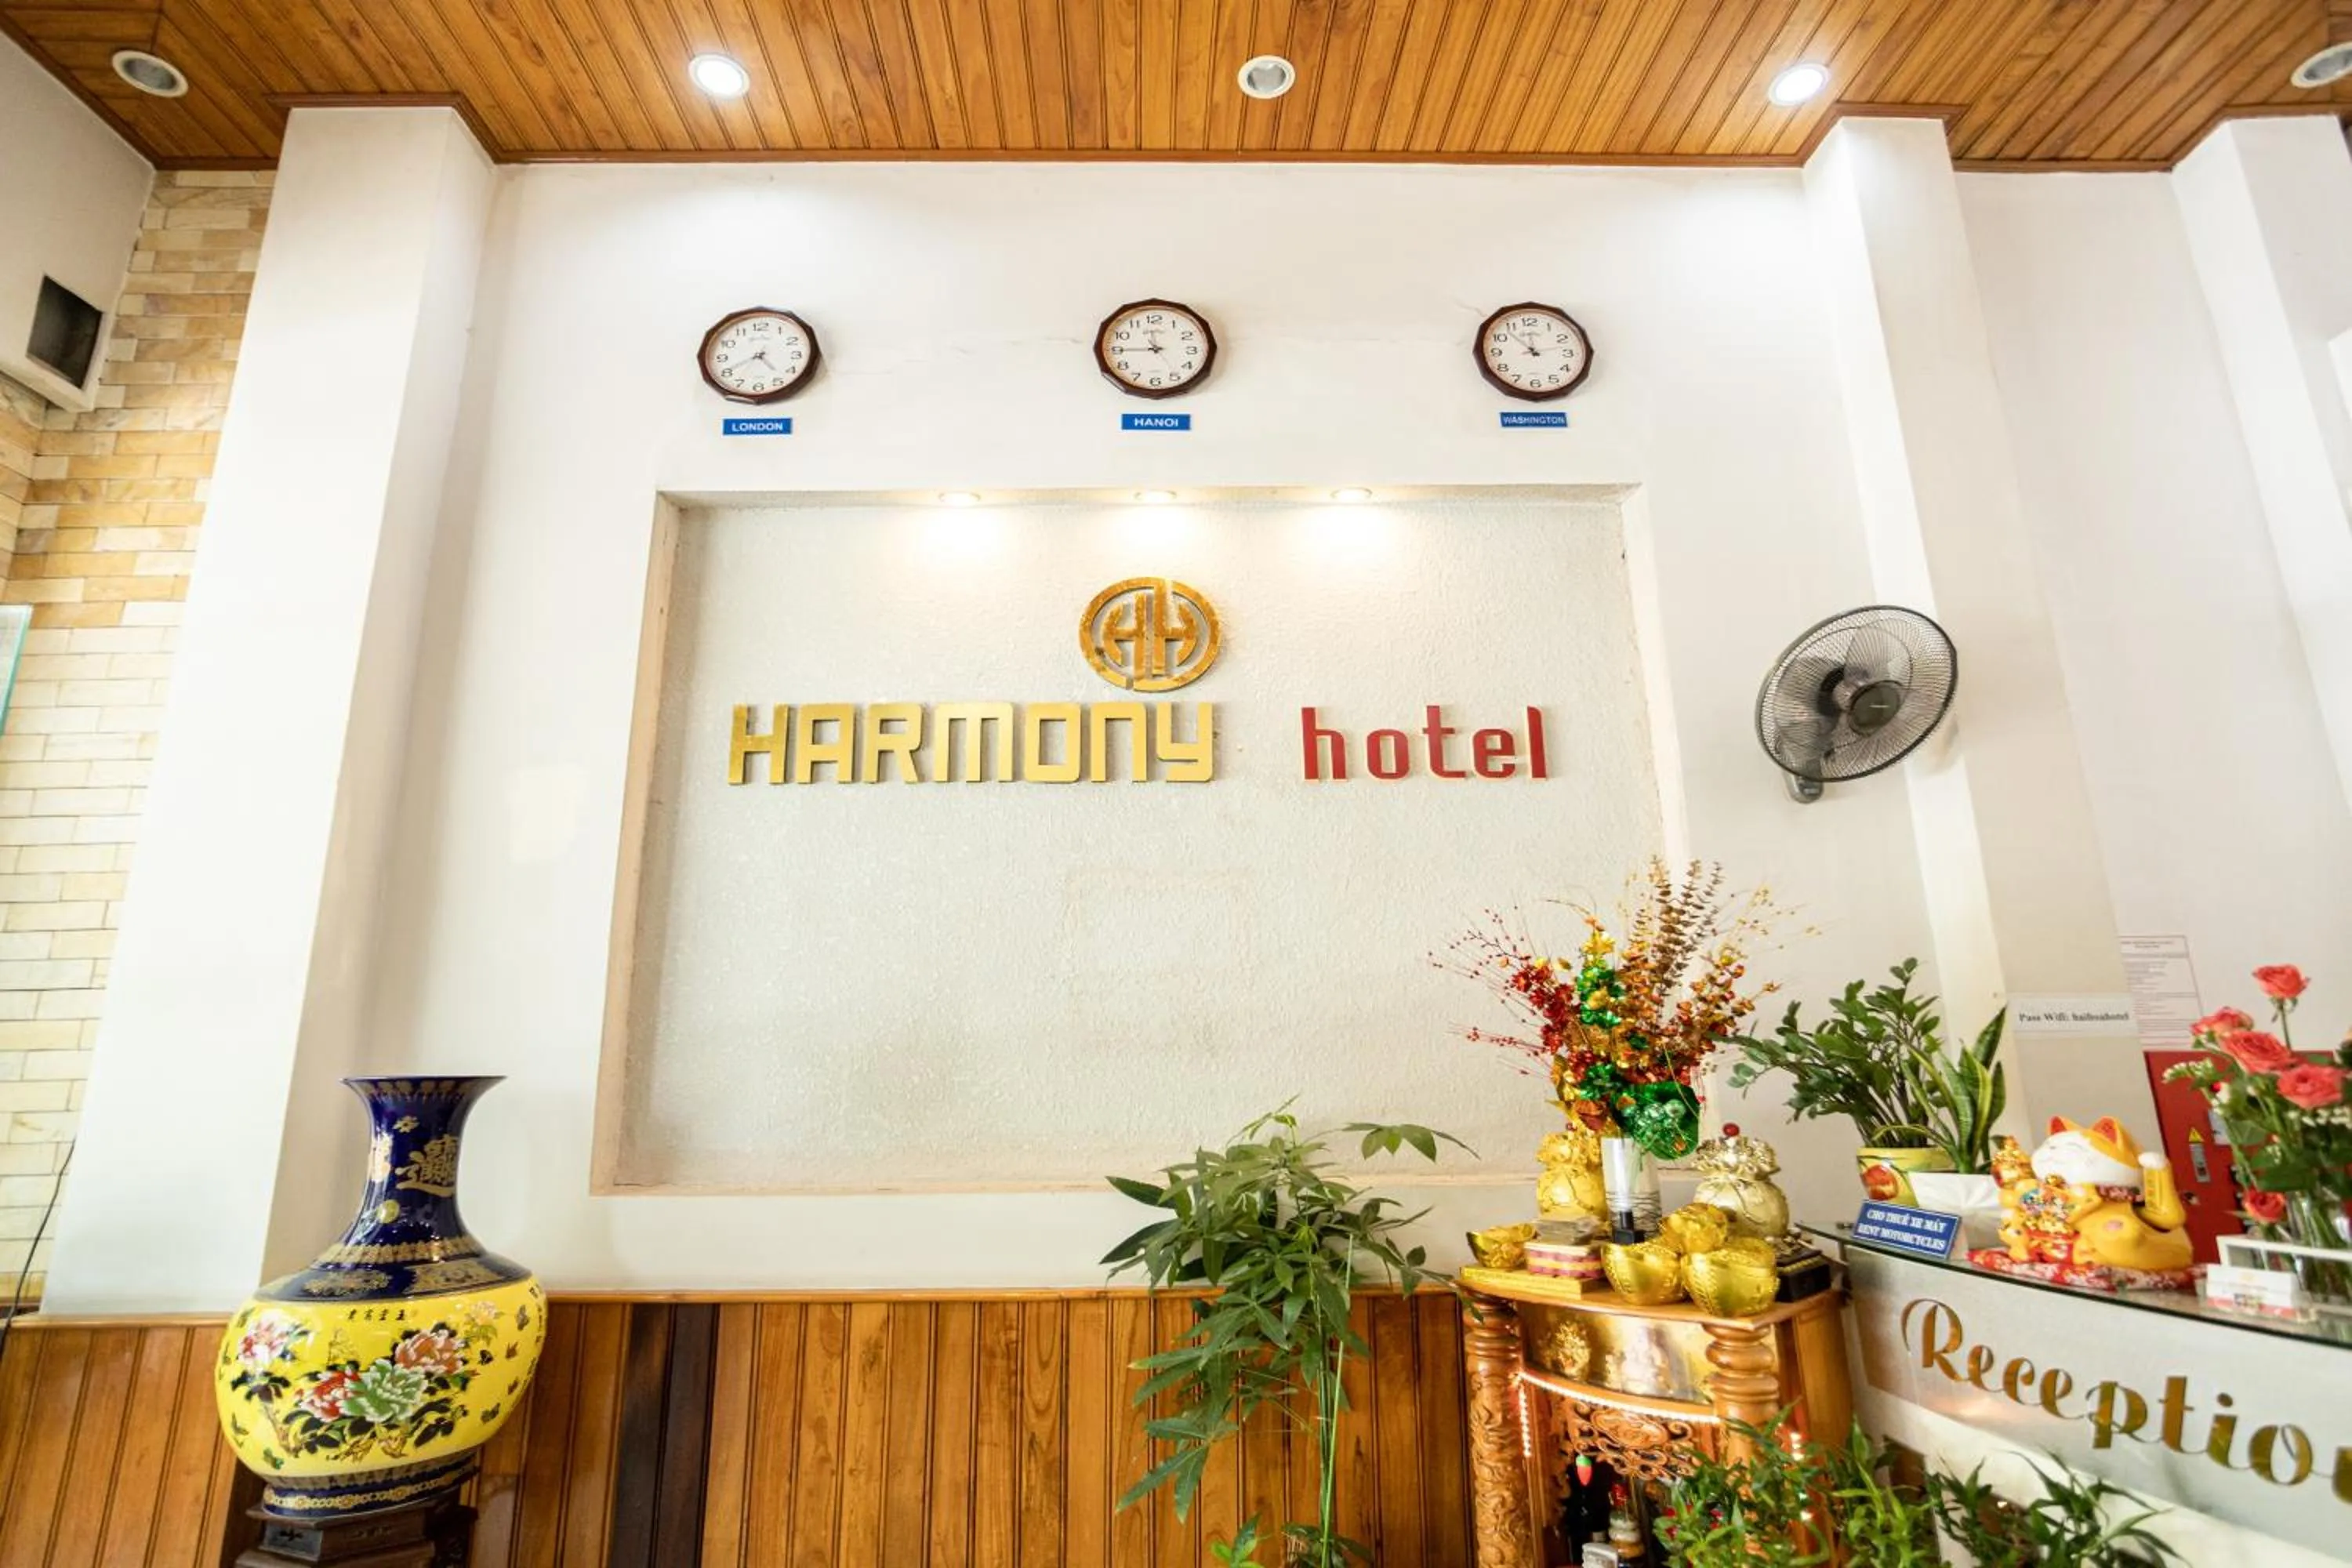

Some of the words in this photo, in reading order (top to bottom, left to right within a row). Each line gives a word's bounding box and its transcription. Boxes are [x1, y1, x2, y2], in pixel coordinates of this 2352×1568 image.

[1146, 314, 1162, 324] 12
[1522, 318, 1537, 326] 12
[753, 322, 769, 332] 12
[1130, 320, 1140, 328] 11
[1171, 320, 1175, 328] 1
[1507, 322, 1516, 331] 11
[1547, 322, 1551, 331] 1
[778, 326, 782, 335] 1
[1116, 332, 1130, 340] 10
[1181, 331, 1193, 340] 2
[1494, 333, 1507, 343] 10
[1556, 333, 1568, 343] 2
[721, 339, 735, 348] 10
[786, 336, 798, 346] 2
[791, 350, 802, 359] 3
[1111, 347, 1123, 355] 9
[1186, 347, 1197, 355] 3
[1490, 348, 1502, 358] 9
[1562, 349, 1573, 358] 3
[717, 354, 728, 362] 9
[1117, 361, 1129, 370] 8
[1181, 361, 1192, 370] 4
[1559, 363, 1570, 372] 4
[721, 368, 733, 377] 8
[1131, 372, 1141, 381] 7
[1169, 372, 1181, 381] 5
[735, 379, 745, 387] 7
[773, 378, 784, 387] 5
[1149, 377, 1161, 387] 6
[1512, 374, 1522, 383] 7
[1548, 375, 1559, 383] 5
[753, 383, 764, 392] 6
[1530, 379, 1541, 388] 6
[1134, 418, 1178, 427] HANOI
[1503, 416, 1566, 425] WASHINGTON
[732, 423, 783, 431] LONDON
[729, 702, 1214, 784] HARMONY
[1302, 705, 1548, 781] hotel
[2019, 1013, 2041, 1022] Pass
[1867, 1209, 1886, 1221] CHO
[1909, 1217, 1924, 1229] XE
[1923, 1218, 1947, 1233] MÁY
[1857, 1223, 1880, 1236] RENT
[1880, 1228, 1947, 1250] MOTORCYCLES
[1900, 1298, 2352, 1504] Receptio
